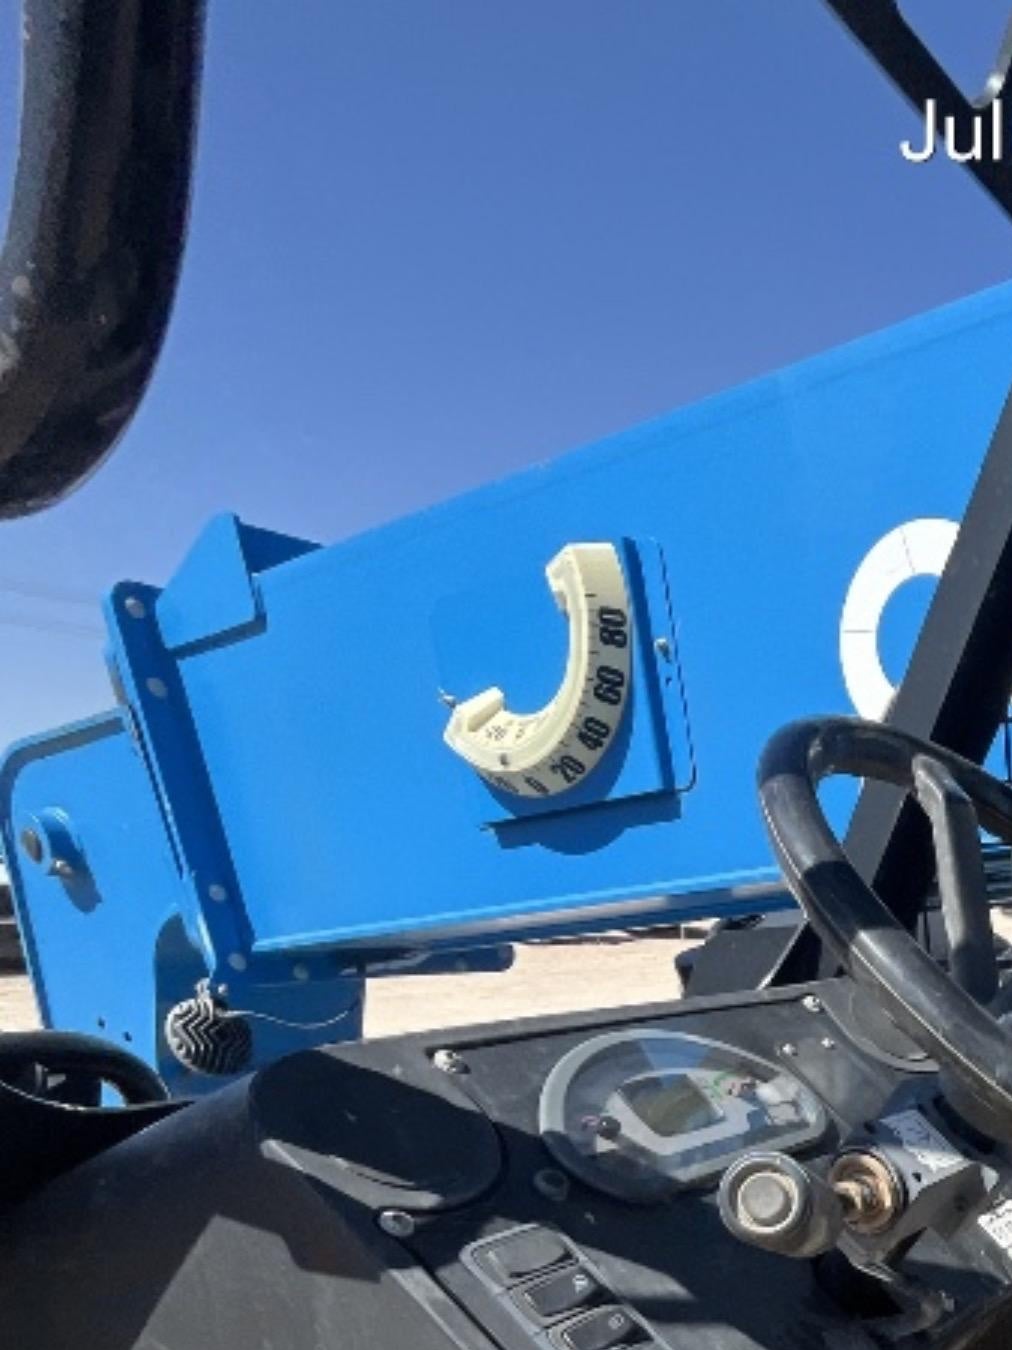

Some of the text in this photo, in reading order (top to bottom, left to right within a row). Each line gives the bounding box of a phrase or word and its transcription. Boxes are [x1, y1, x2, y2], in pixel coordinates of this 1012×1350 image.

[599, 605, 628, 649] 80
[593, 665, 625, 706] 60
[577, 716, 611, 751] 40
[550, 754, 587, 784] 20
